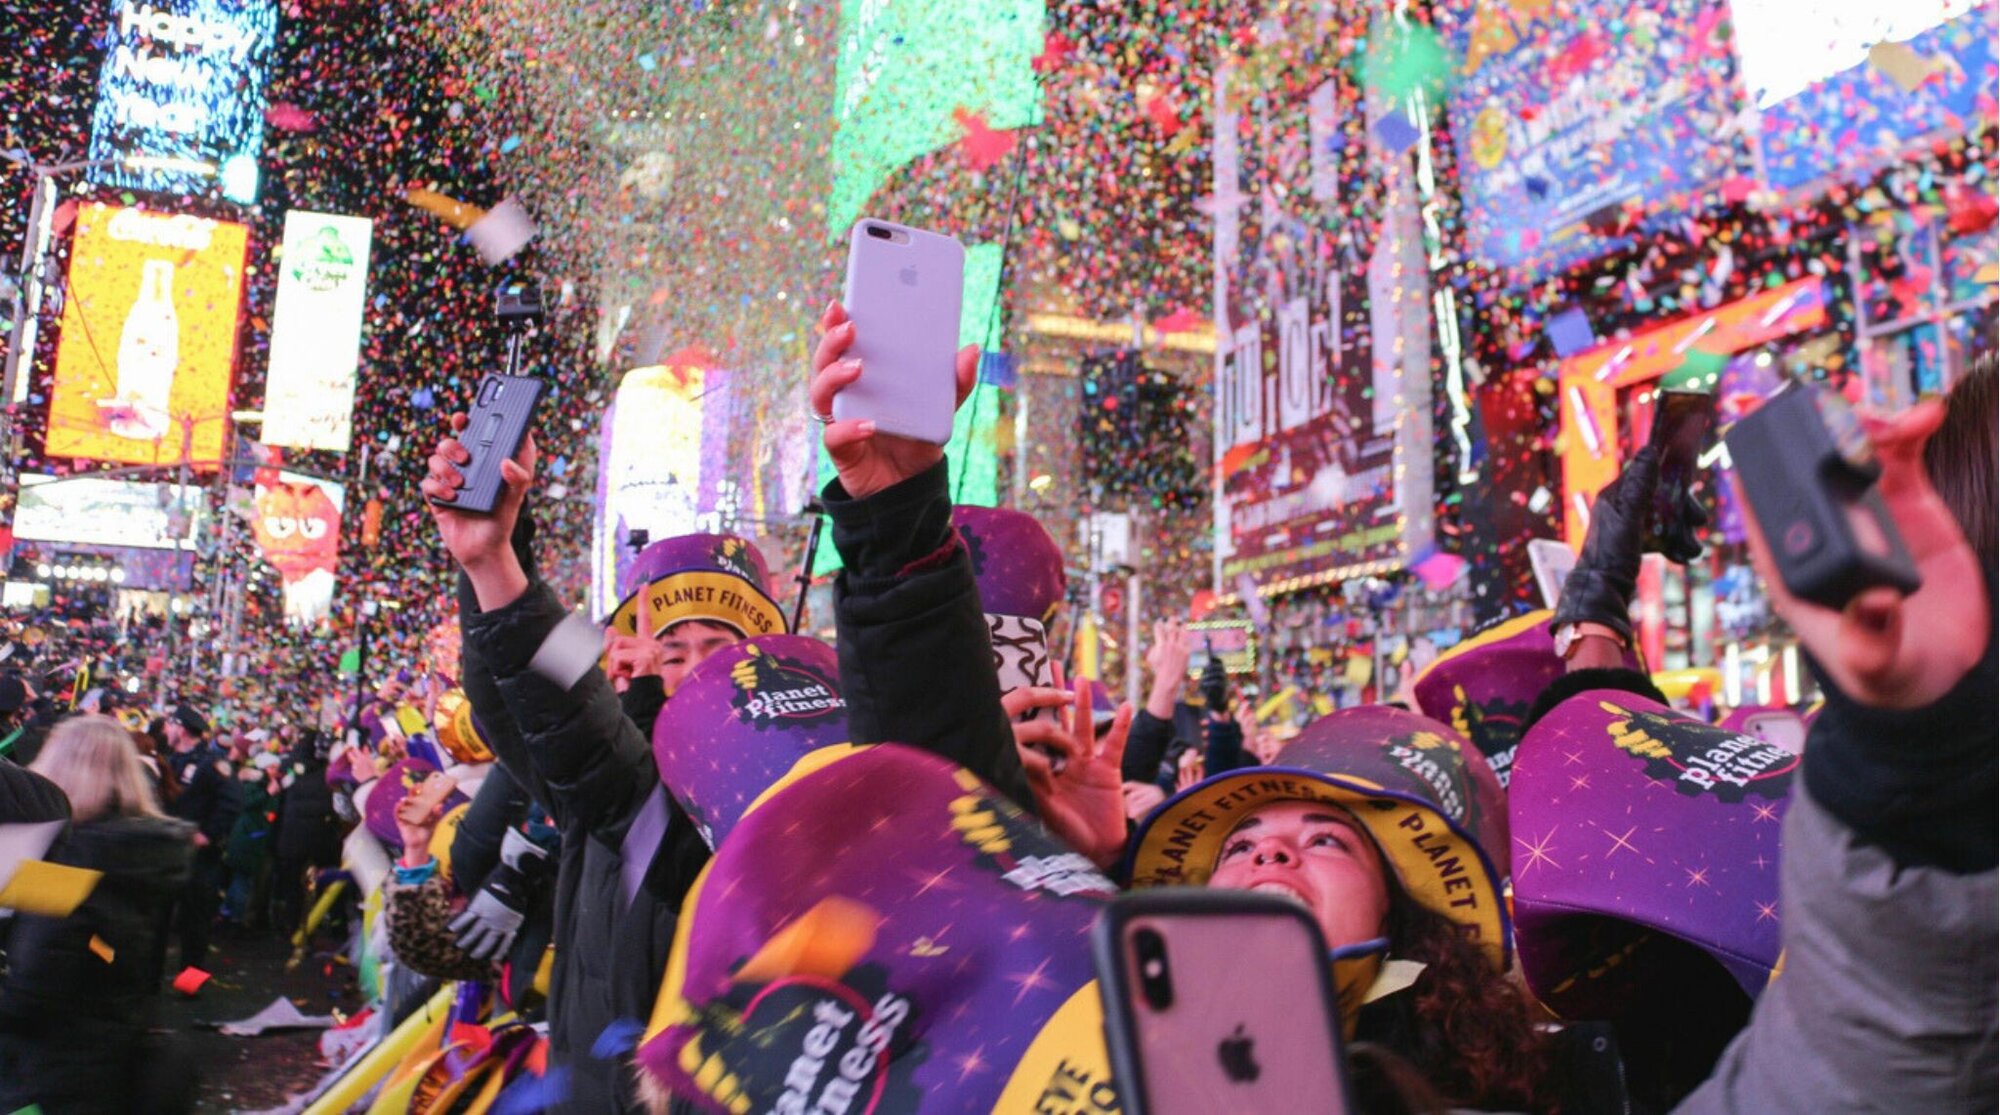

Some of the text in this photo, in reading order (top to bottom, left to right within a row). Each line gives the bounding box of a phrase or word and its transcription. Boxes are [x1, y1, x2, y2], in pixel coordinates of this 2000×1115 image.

[121, 0, 258, 64] Happy
[652, 586, 773, 634] PLANET FITNESS
[744, 684, 830, 719] planet
[763, 698, 847, 719] fitness
[1679, 734, 1759, 790] plane
[1716, 746, 1791, 788] fitne
[1398, 812, 1478, 910] PLANET
[765, 999, 855, 1115] anet
[805, 991, 910, 1115] ness
